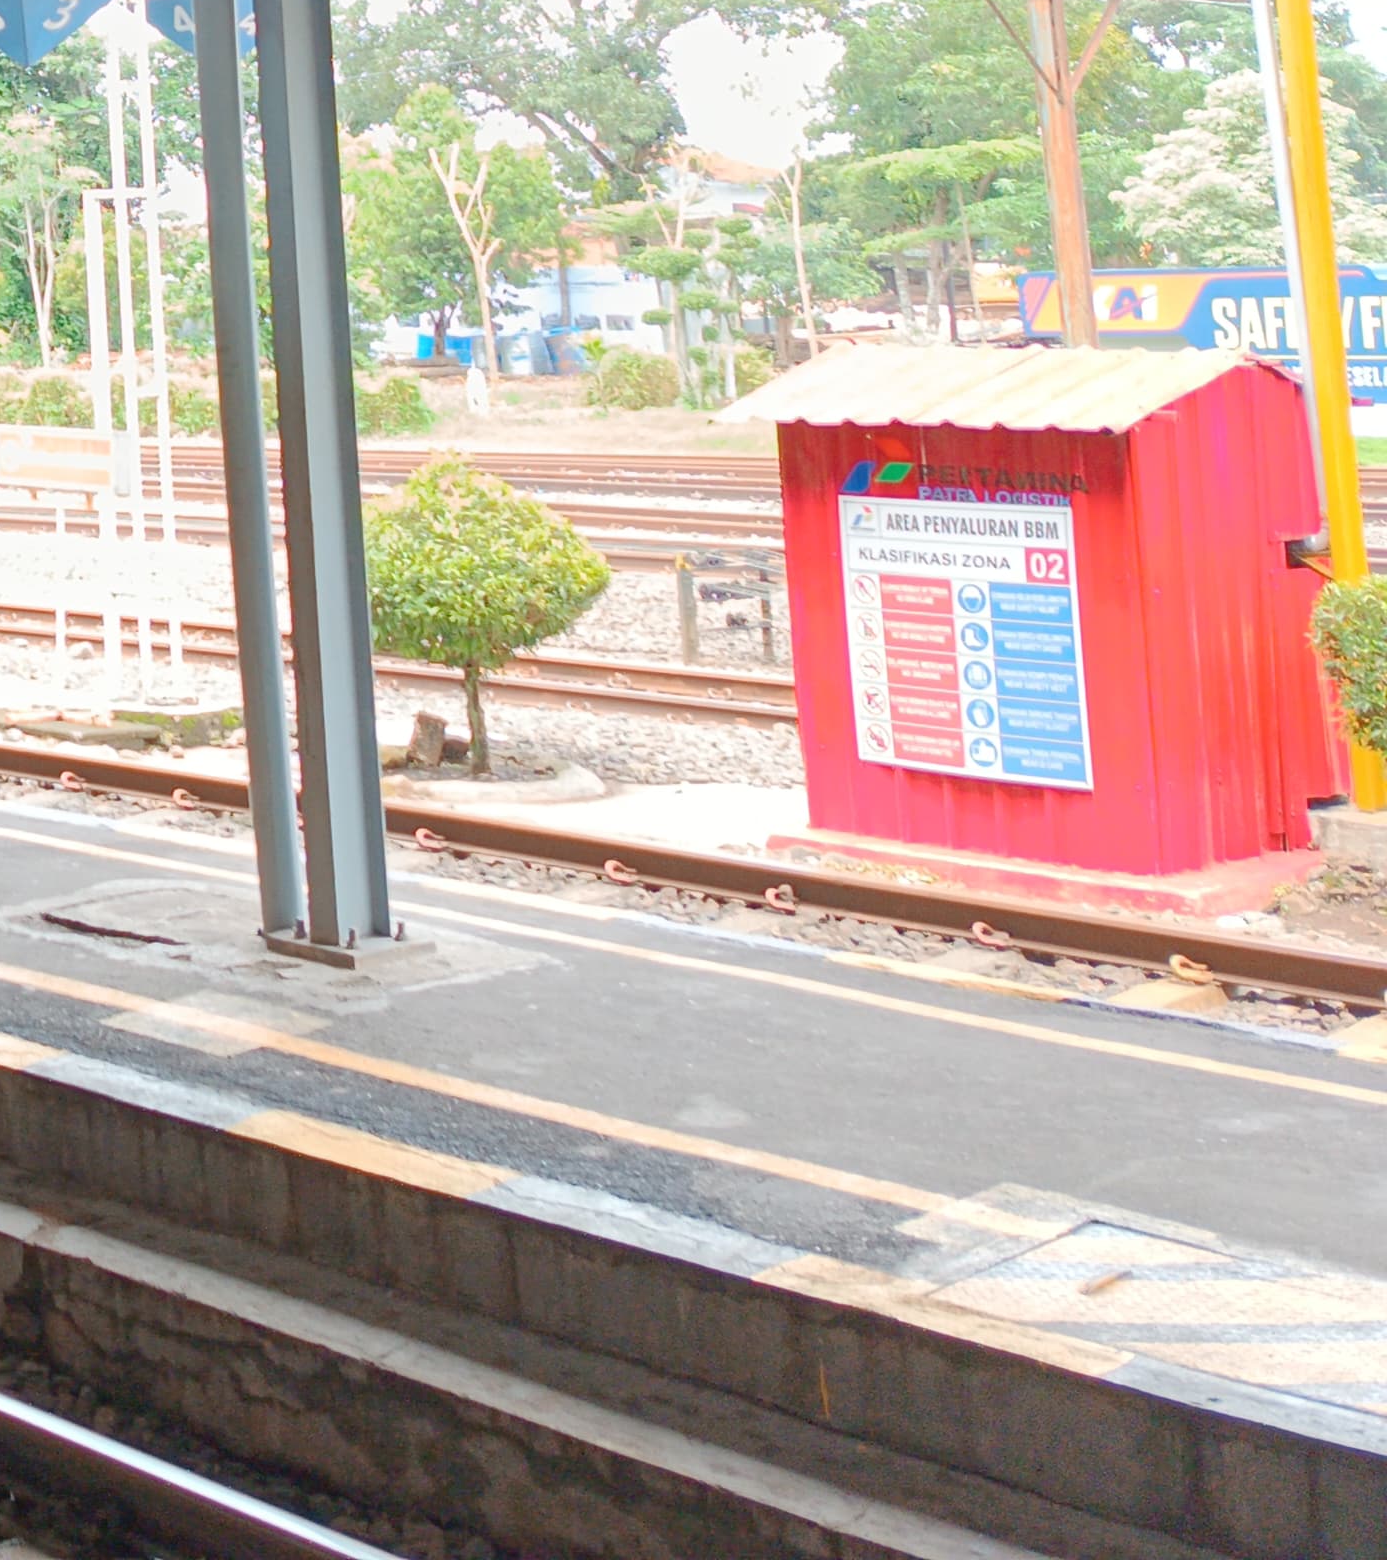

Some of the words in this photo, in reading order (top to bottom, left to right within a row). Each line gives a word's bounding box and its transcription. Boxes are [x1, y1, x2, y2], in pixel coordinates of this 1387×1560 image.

[886, 513, 920, 533] AREA
[924, 516, 1019, 538] PENYALURAN
[1026, 521, 1059, 540] BBM
[858, 547, 957, 567] KLASIFIKASI
[962, 554, 1011, 570] ZONA
[1030, 553, 1066, 580] 02
